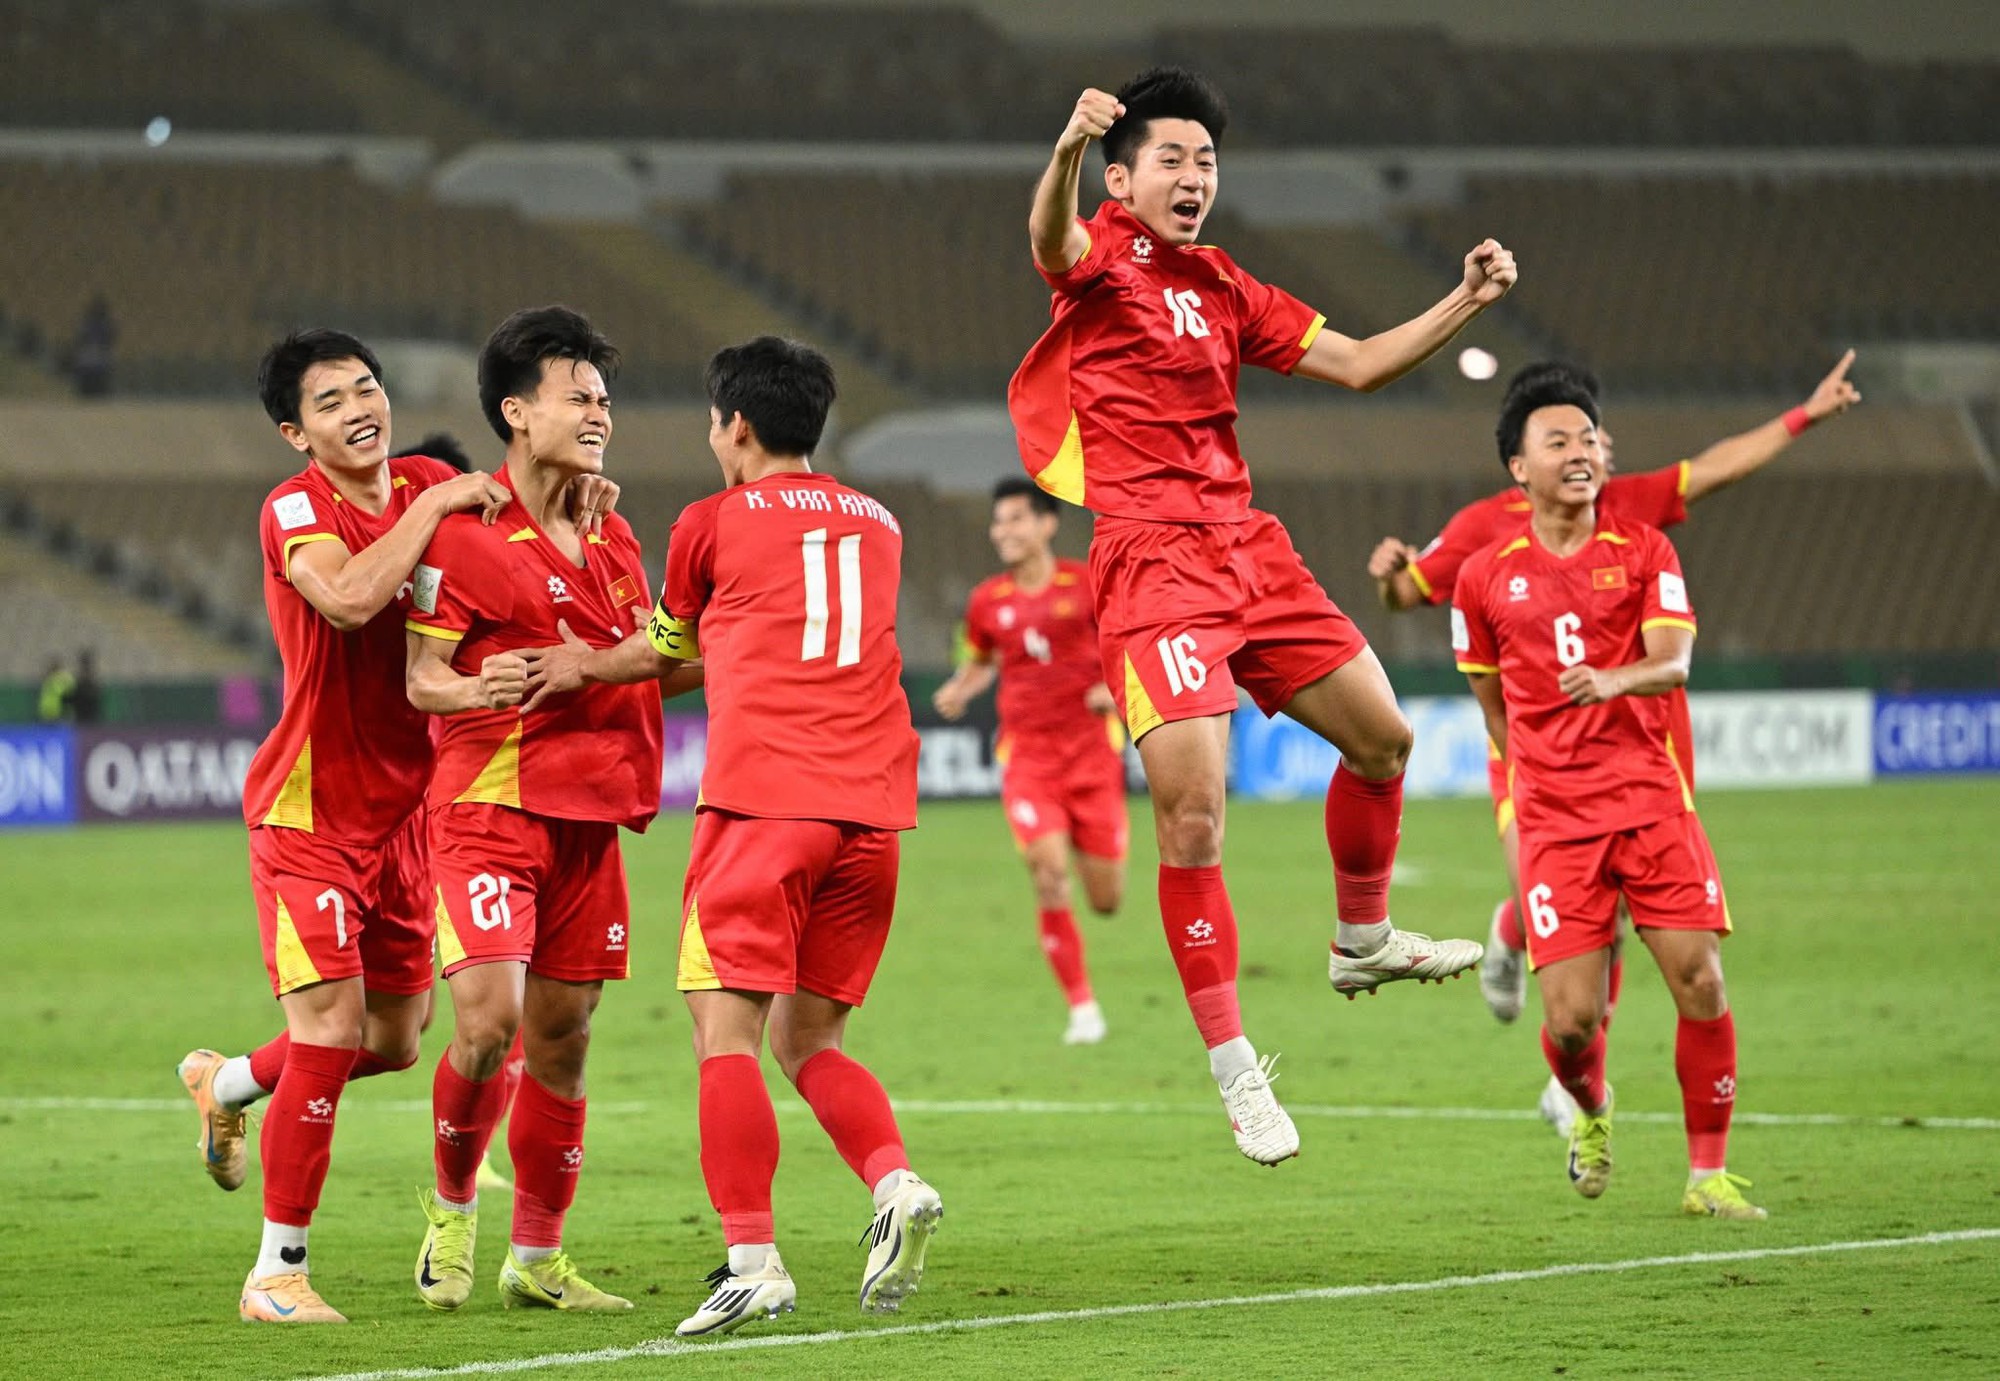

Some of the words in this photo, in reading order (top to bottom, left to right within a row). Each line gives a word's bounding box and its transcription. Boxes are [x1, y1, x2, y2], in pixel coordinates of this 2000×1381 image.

[1163, 287, 1211, 339] 16
[744, 490, 773, 510] K.
[778, 489, 832, 513] VAN
[801, 527, 862, 668] 11
[650, 616, 684, 650] AFC
[1553, 611, 1586, 667] 6
[1157, 632, 1207, 697] 16
[315, 887, 347, 950] 7
[467, 872, 512, 931] 21
[1527, 882, 1560, 939] 6
